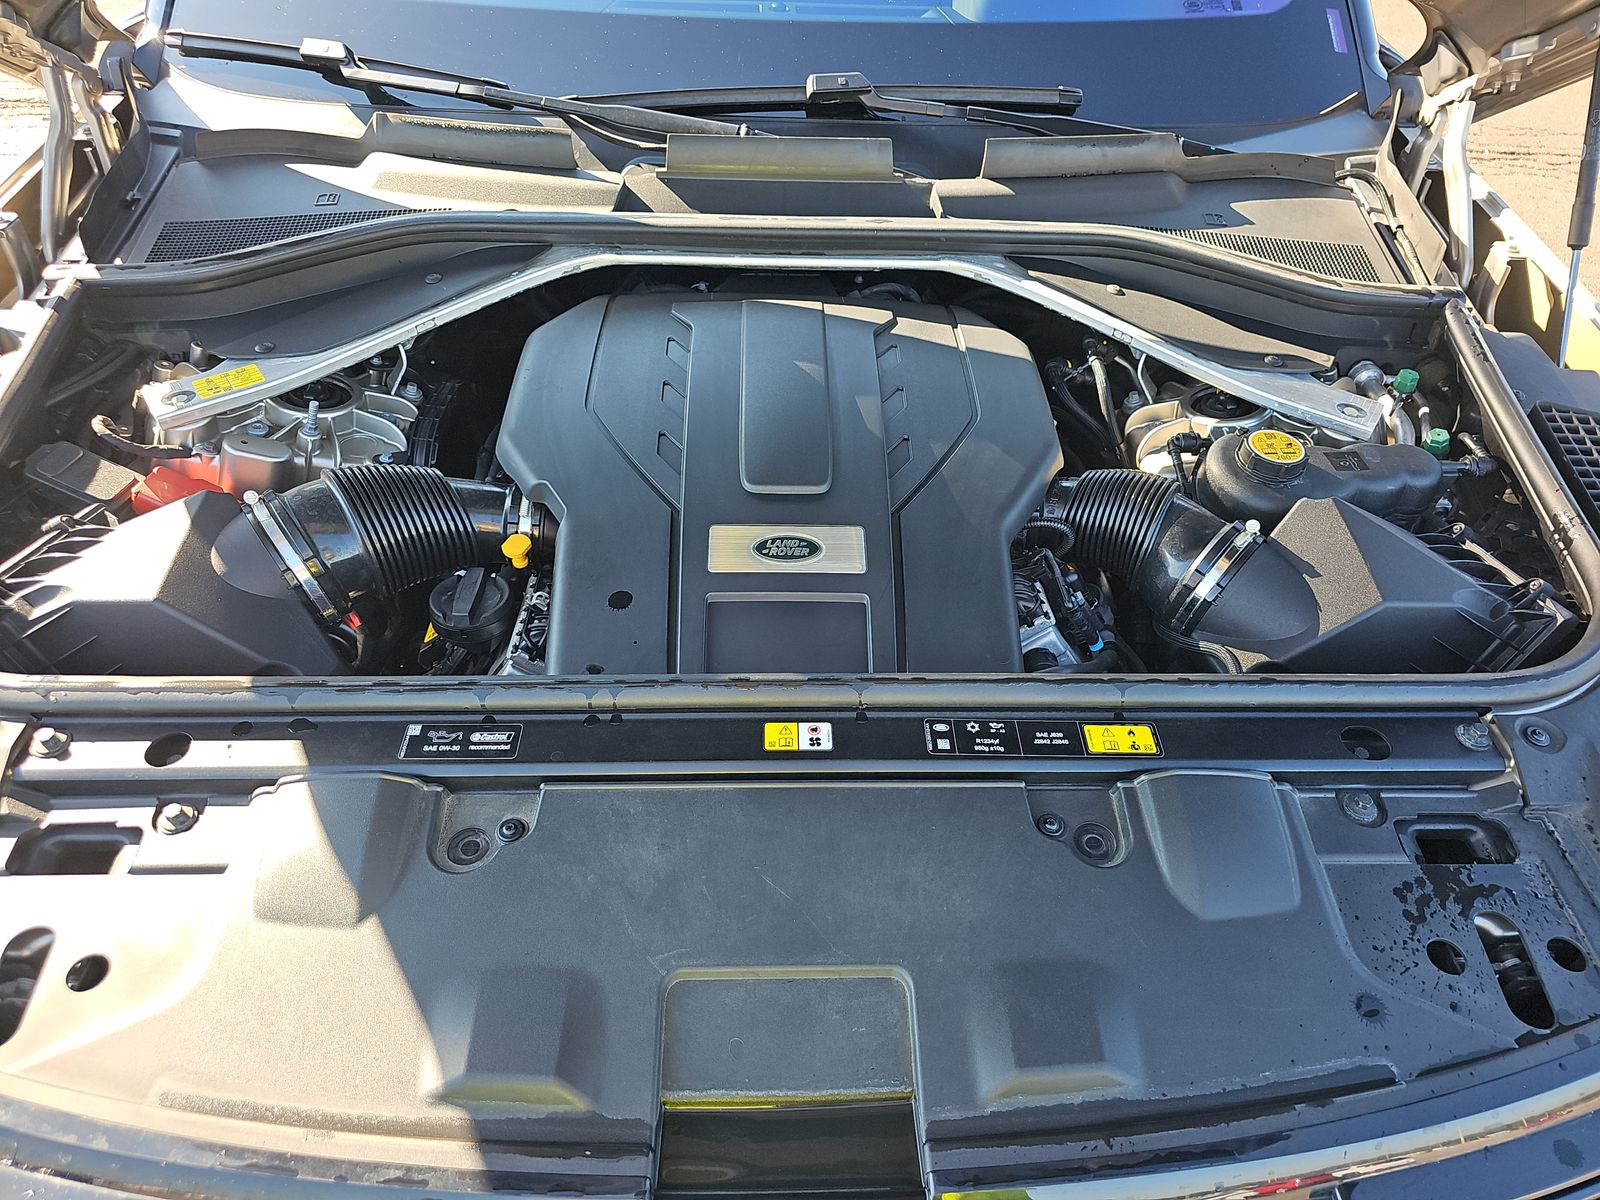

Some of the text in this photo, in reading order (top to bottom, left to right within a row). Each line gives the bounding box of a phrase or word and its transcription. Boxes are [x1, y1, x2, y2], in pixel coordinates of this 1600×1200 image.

[766, 540, 800, 548] LAND
[768, 547, 810, 556] ROVER
[480, 732, 508, 740] Castrol
